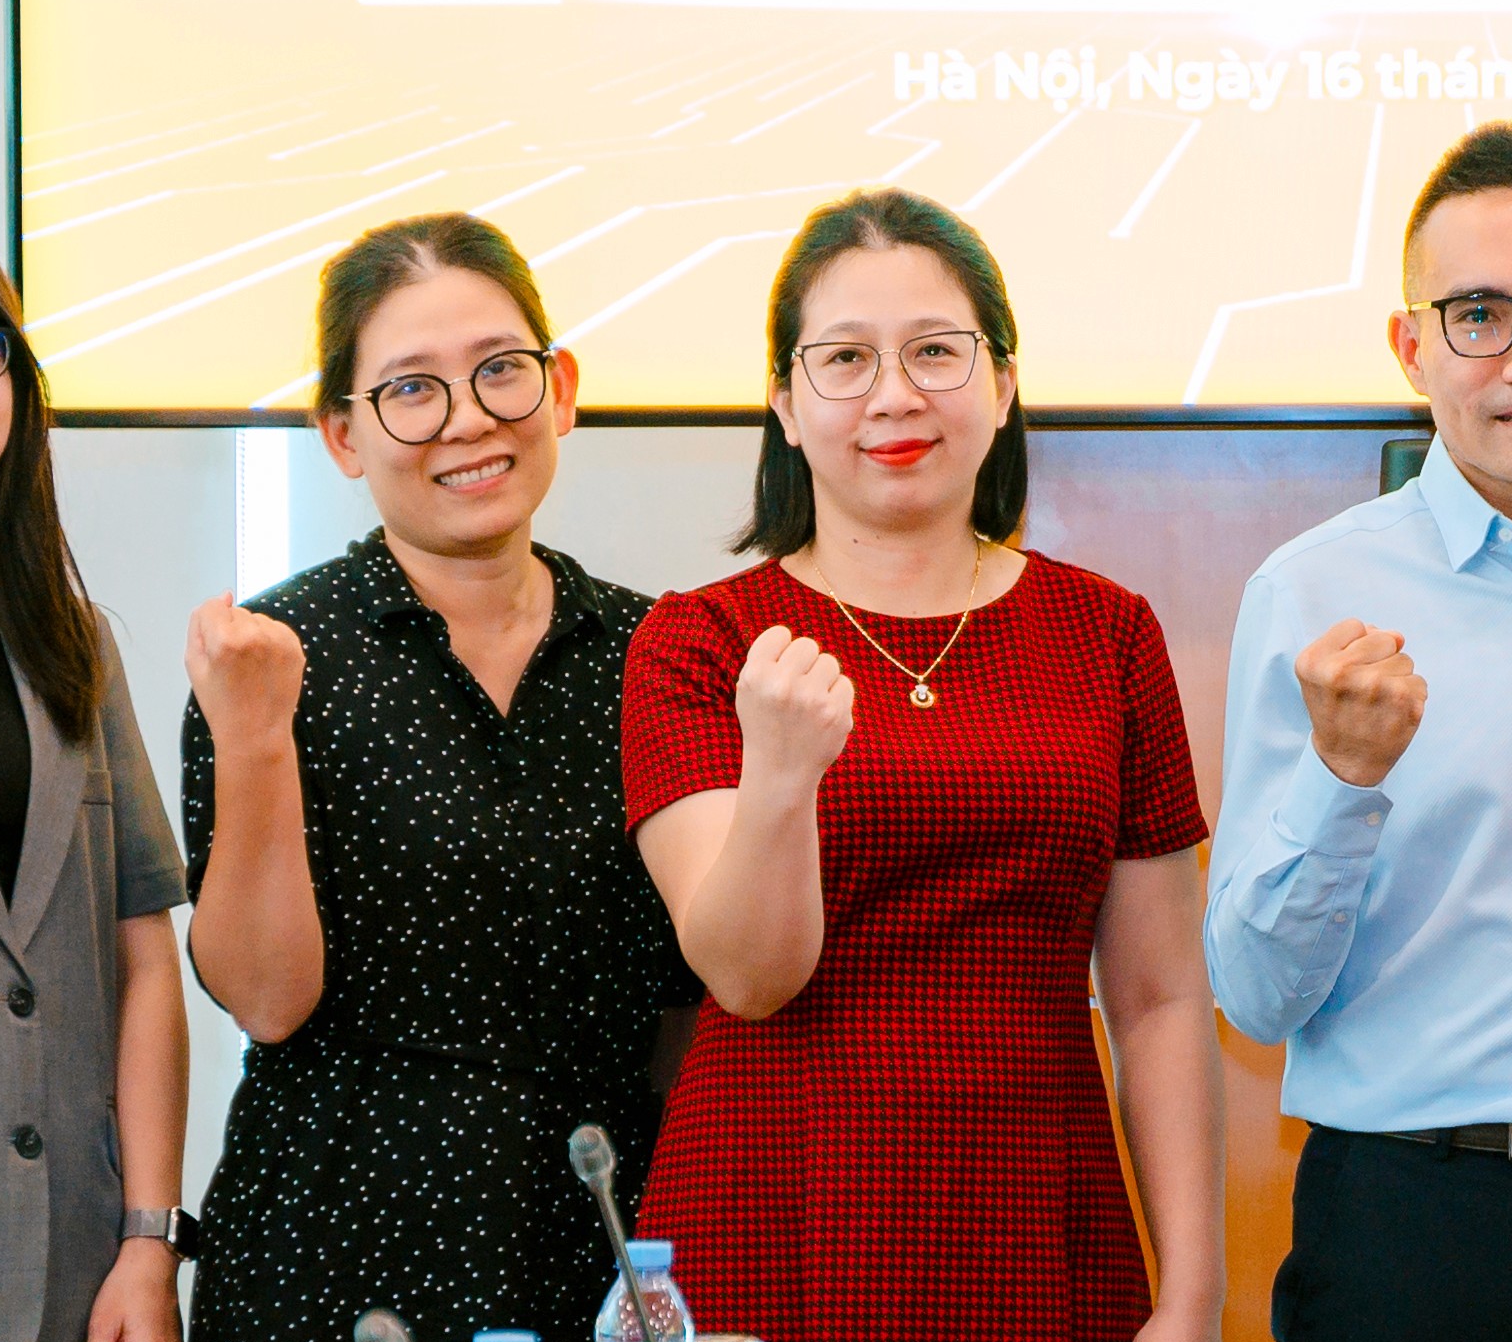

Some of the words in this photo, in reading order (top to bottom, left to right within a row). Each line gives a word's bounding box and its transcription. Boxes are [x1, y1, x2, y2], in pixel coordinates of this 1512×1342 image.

[892, 50, 979, 101] Hà
[993, 46, 1112, 111] Nội,
[1127, 50, 1285, 110] Ngày
[1299, 50, 1362, 100] 16
